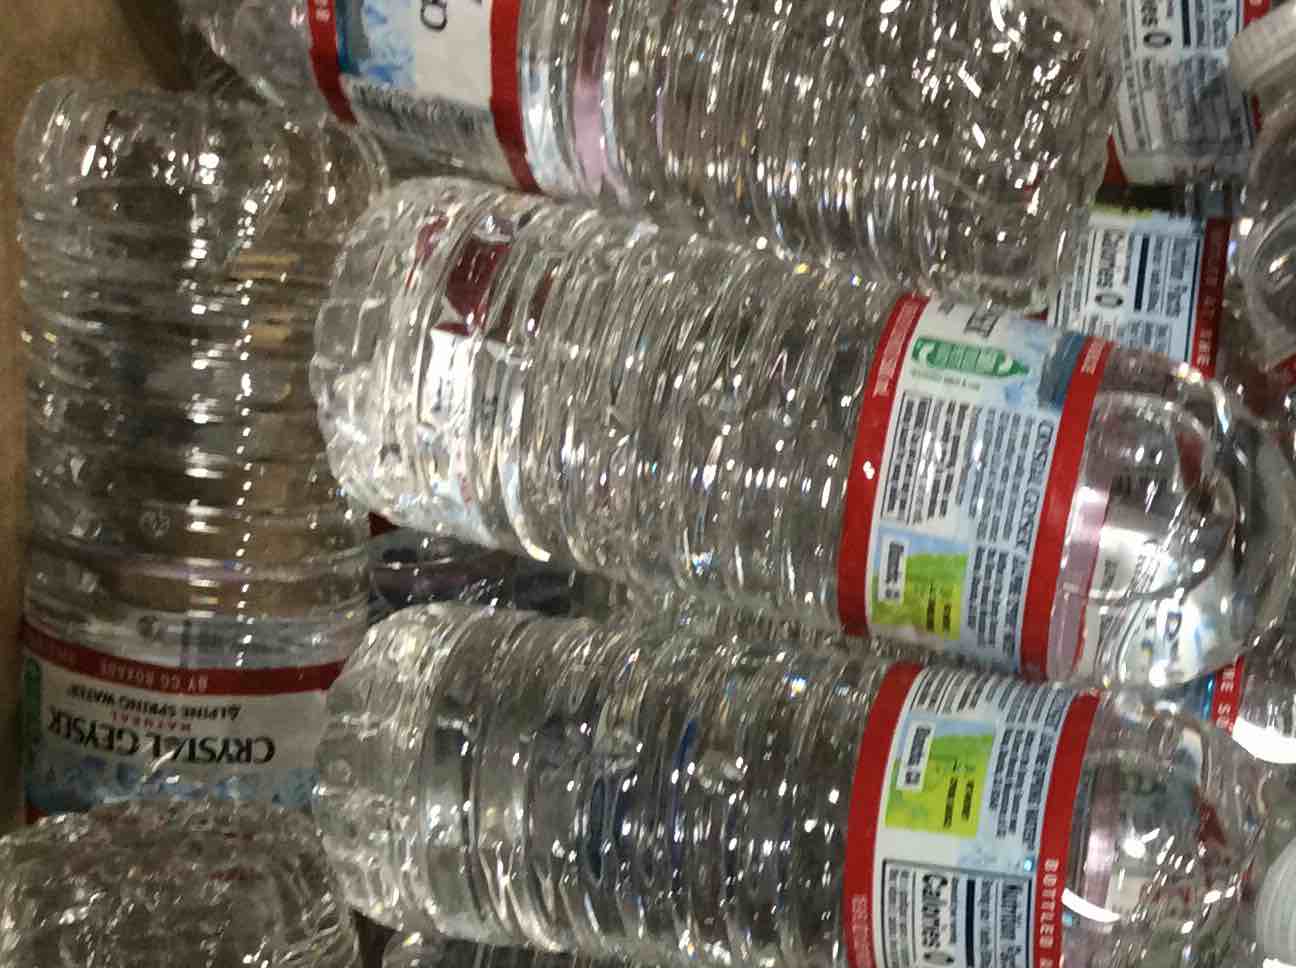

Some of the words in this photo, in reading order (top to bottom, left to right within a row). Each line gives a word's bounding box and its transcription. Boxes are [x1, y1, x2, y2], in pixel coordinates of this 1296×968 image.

[48, 708, 140, 755] GEYSER
[152, 735, 275, 764] CRYSTAL
[920, 873, 948, 948] Calories
